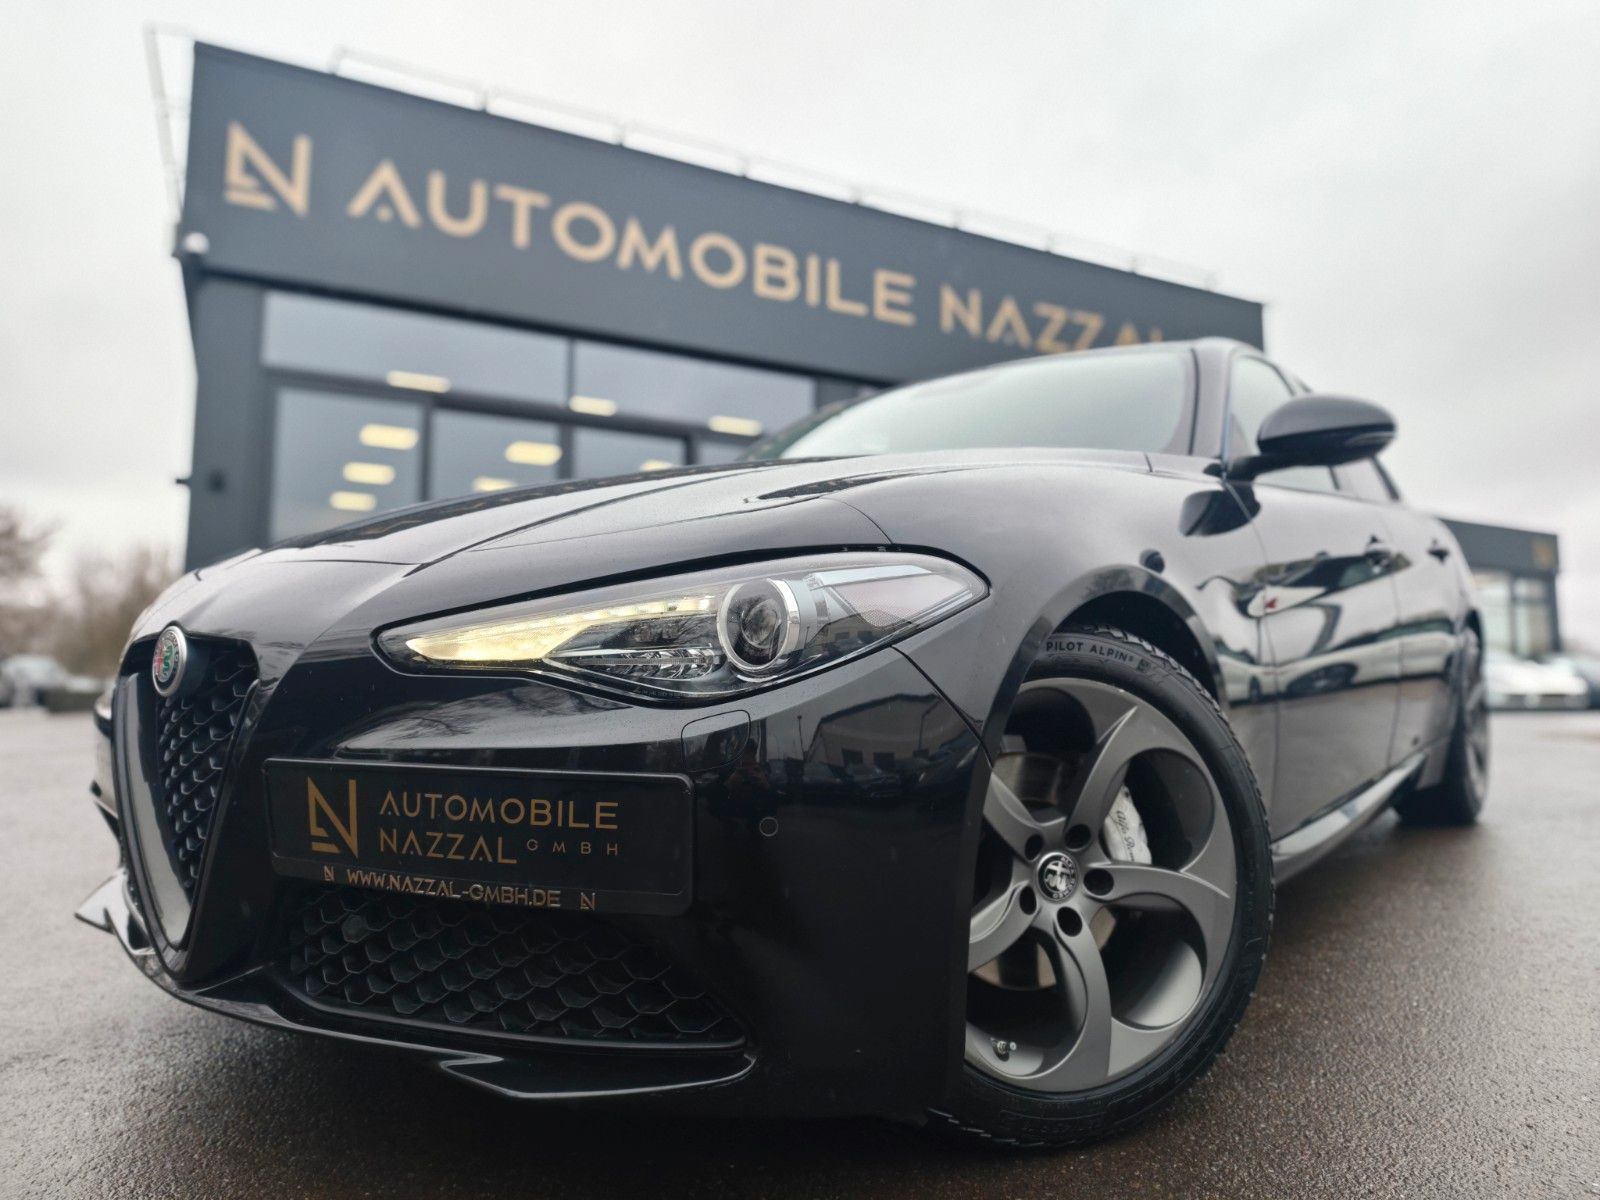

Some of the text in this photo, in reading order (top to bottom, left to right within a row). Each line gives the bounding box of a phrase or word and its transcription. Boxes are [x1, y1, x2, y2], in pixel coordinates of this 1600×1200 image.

[347, 159, 916, 326] AUTOMOBILE
[1046, 641, 1084, 652] PILOT
[379, 790, 619, 829] AUTOMOBILE
[379, 827, 618, 864] NAZZAL GMBH
[346, 868, 561, 908] WWW.NAZZAL-GMBH.DE
